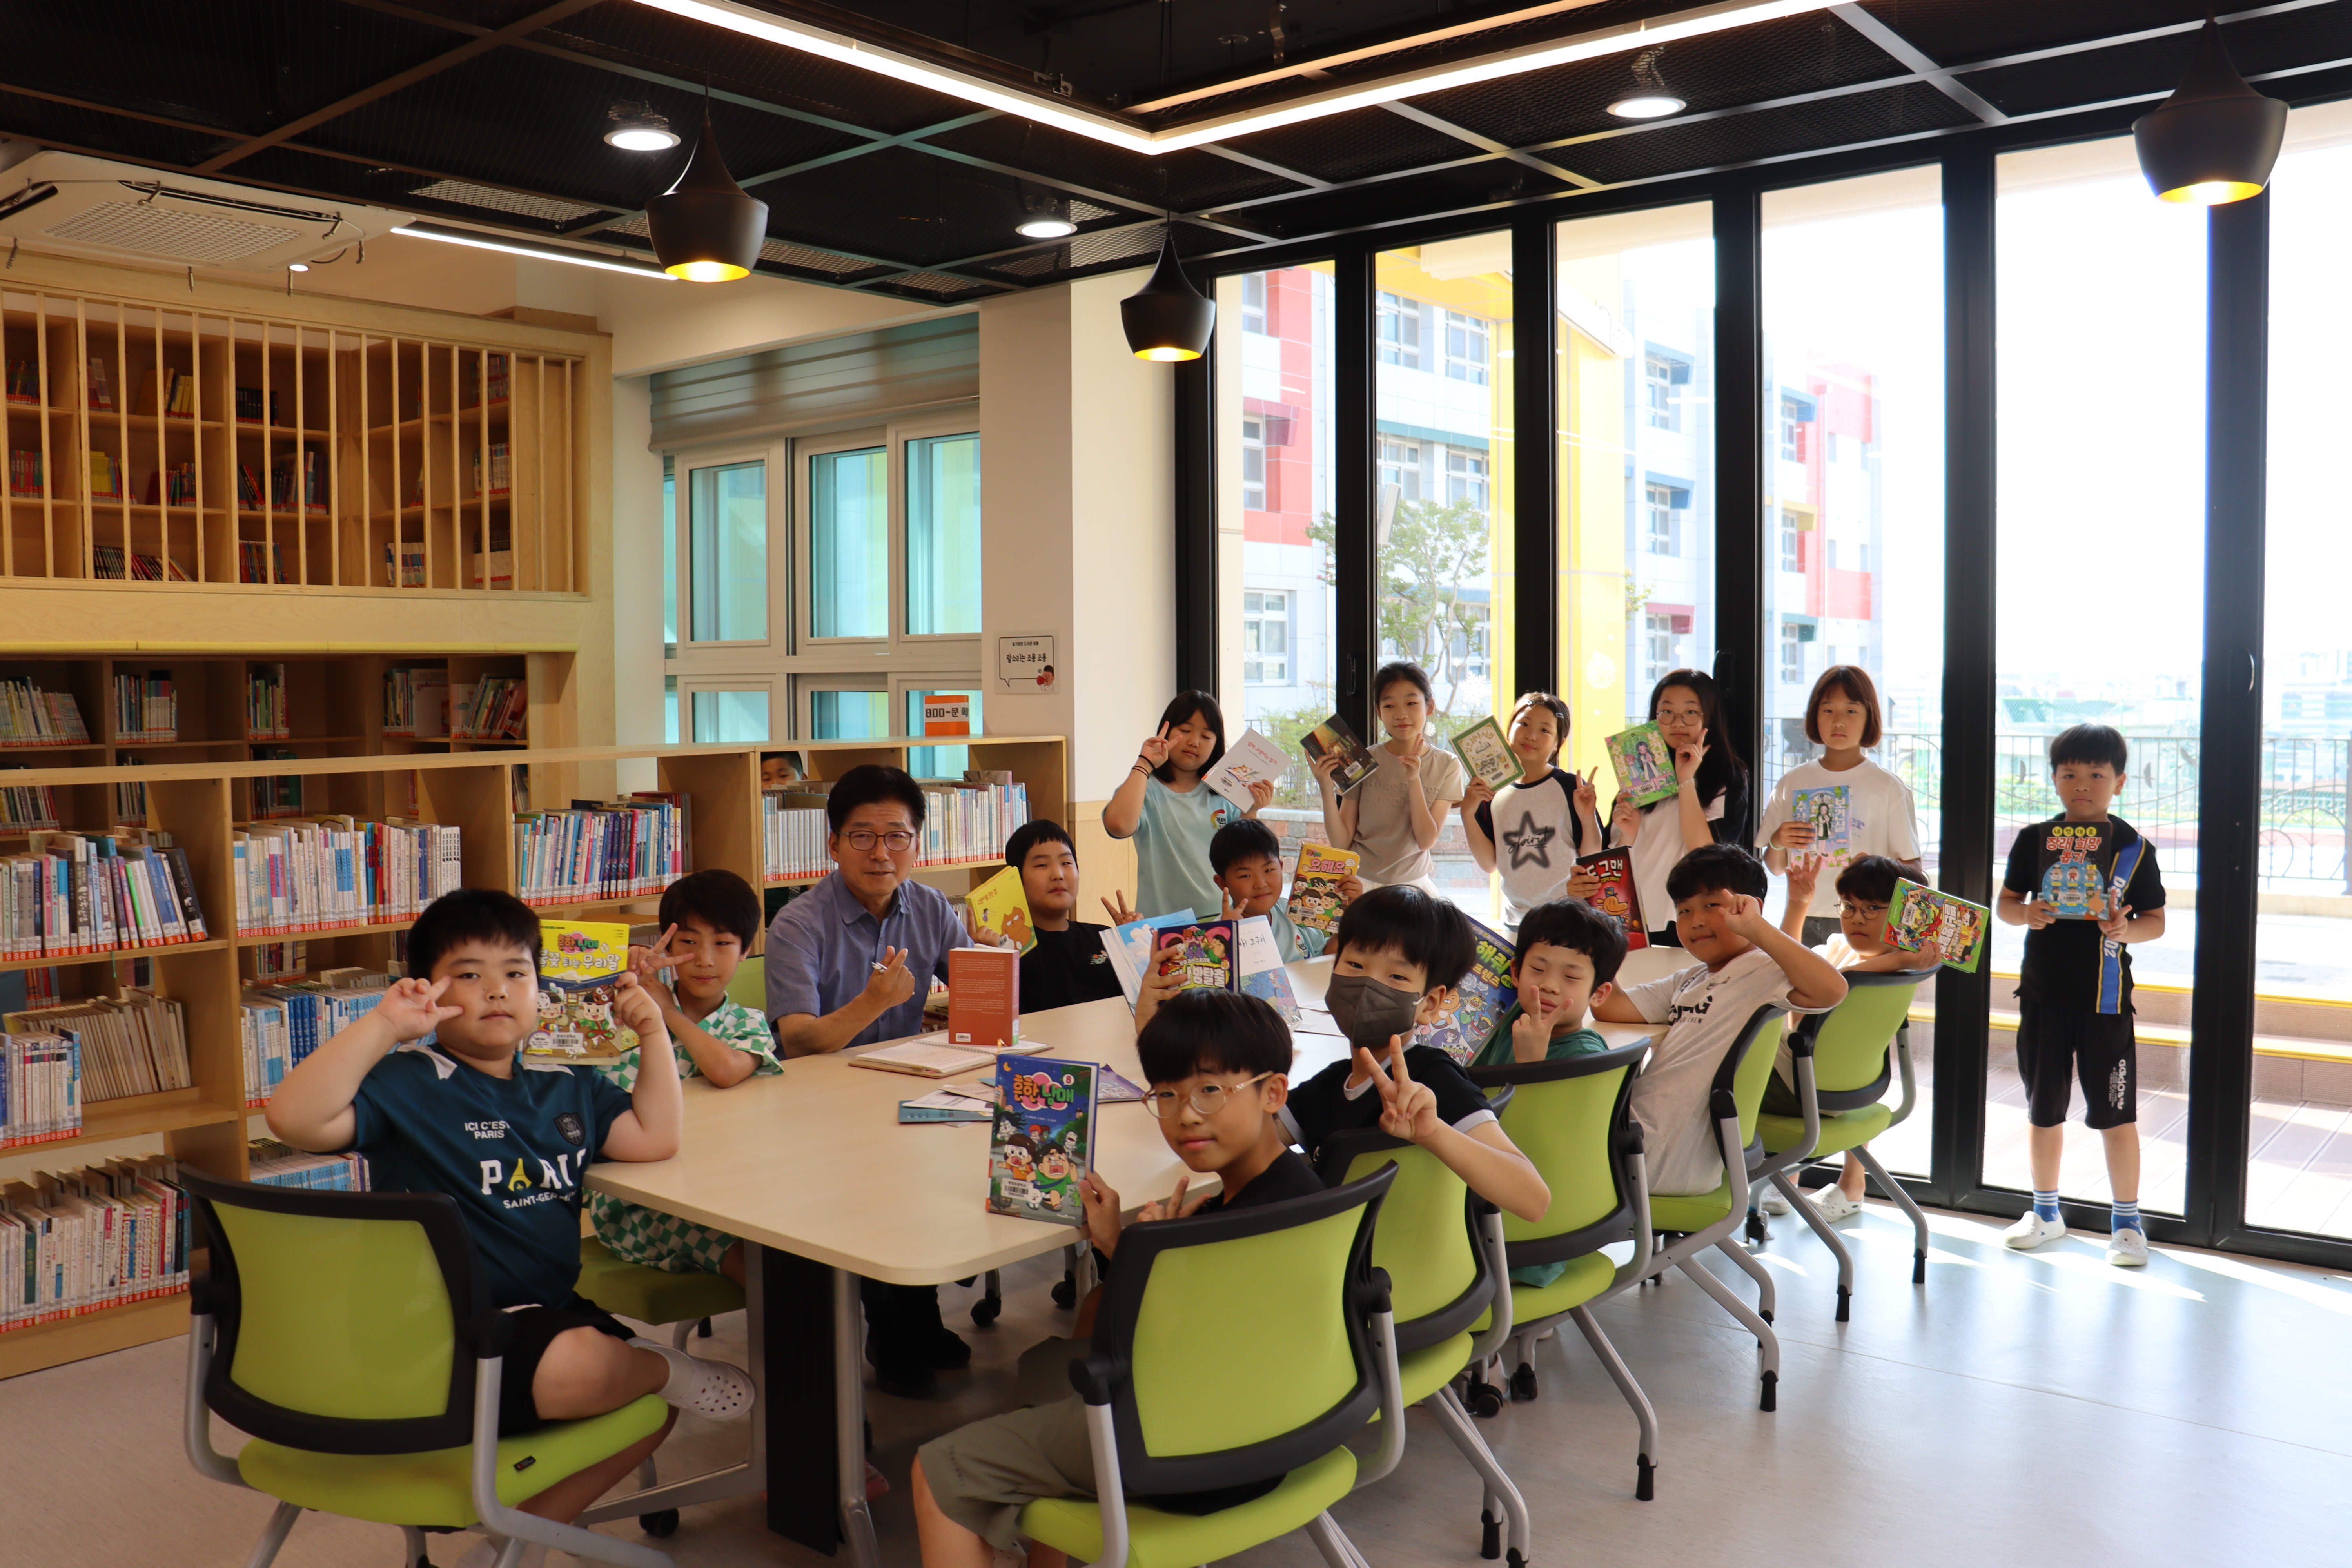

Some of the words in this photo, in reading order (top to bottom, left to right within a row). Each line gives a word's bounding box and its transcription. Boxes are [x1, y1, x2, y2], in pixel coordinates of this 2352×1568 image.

[1006, 653, 1025, 663] 말소리는
[1027, 653, 1036, 662] 조용
[1037, 653, 1047, 662] 조용
[1834, 797, 1846, 833] 보건실
[2046, 837, 2074, 851] 장래
[2074, 837, 2102, 851] 희망
[2060, 850, 2087, 864] 뽑기
[562, 957, 581, 969] 튀는
[582, 954, 621, 971] 우리말
[1475, 936, 1511, 974] 해줘
[1193, 965, 1225, 988] 방탈출
[1472, 963, 1501, 988] 프렌즈
[2117, 1059, 2127, 1098] adidas
[1013, 1074, 1040, 1102] 흔한
[1041, 1084, 1074, 1106] 남매
[1066, 1075, 1071, 1084] 8
[465, 1122, 478, 1131] ICI
[474, 1130, 505, 1139] PARIS
